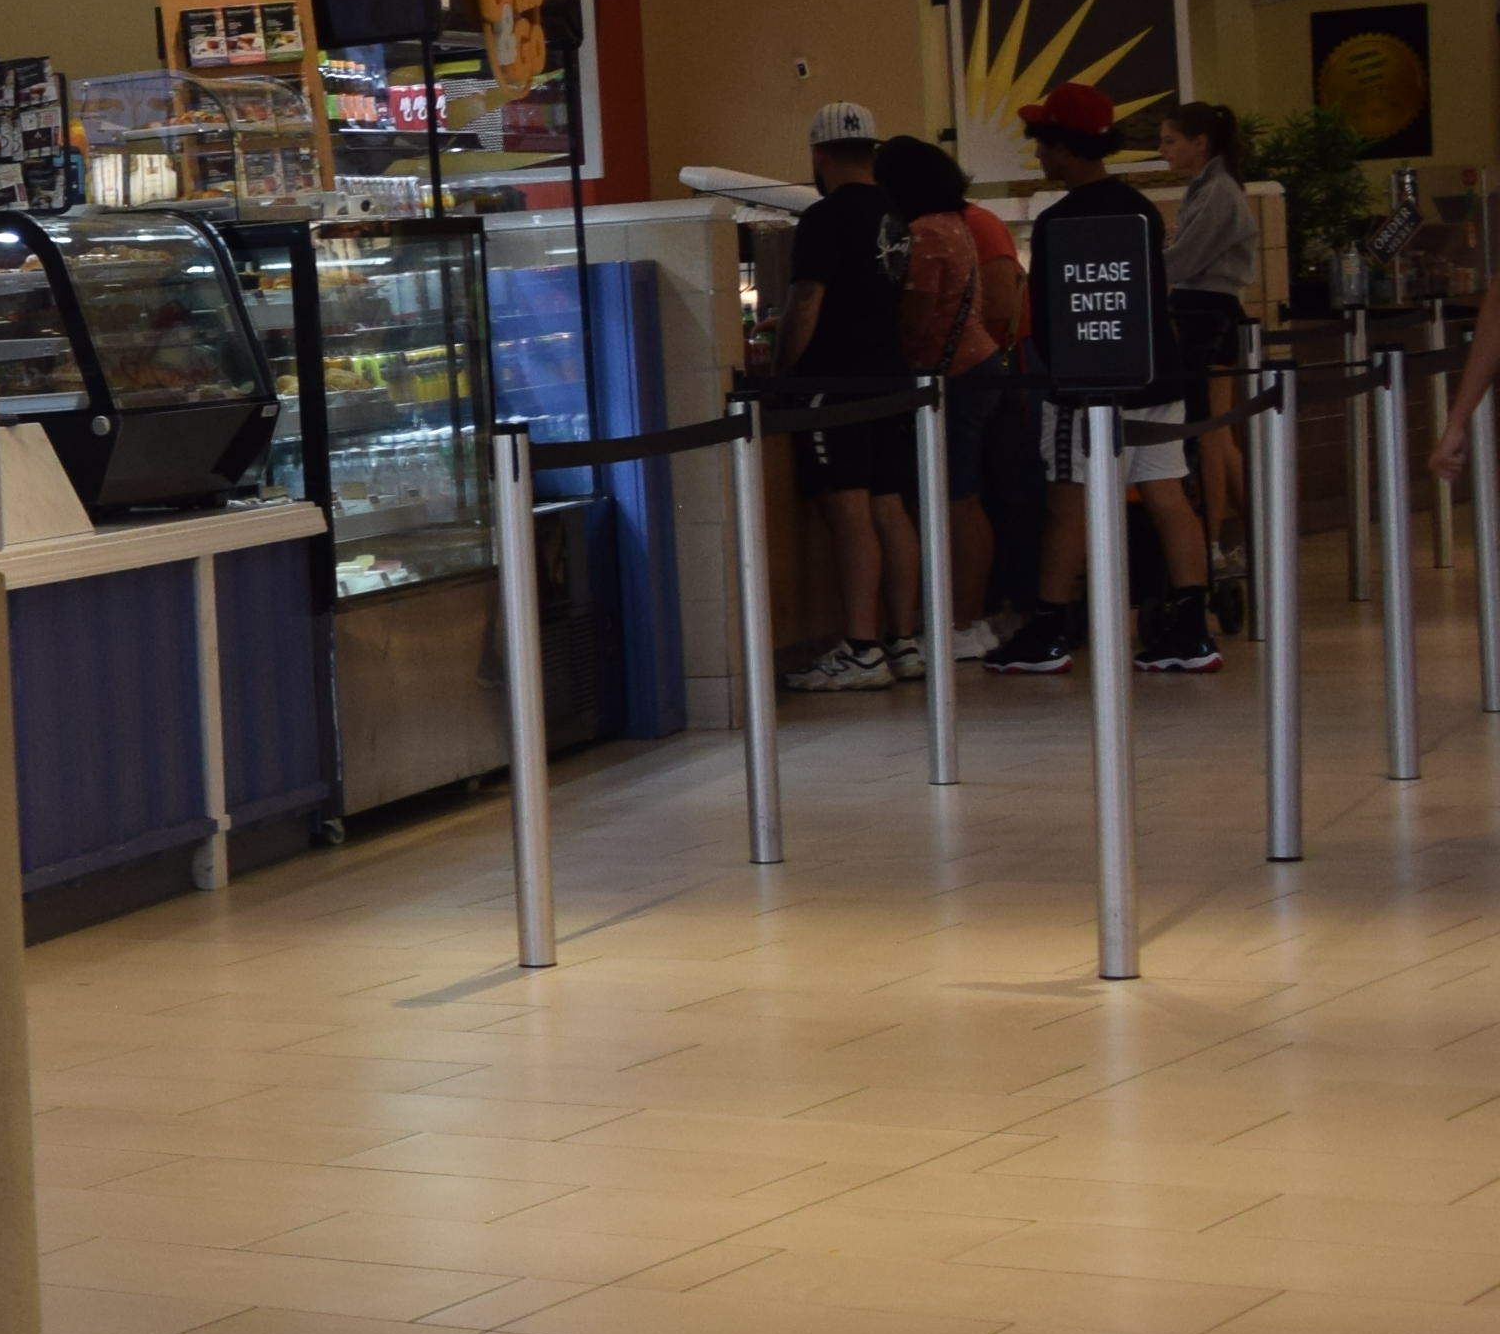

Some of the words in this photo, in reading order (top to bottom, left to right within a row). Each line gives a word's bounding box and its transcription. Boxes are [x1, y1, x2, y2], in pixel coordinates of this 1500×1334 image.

[1064, 262, 1131, 283] PLEASE
[1071, 292, 1126, 312] ENTER
[1077, 321, 1123, 341] HERE
